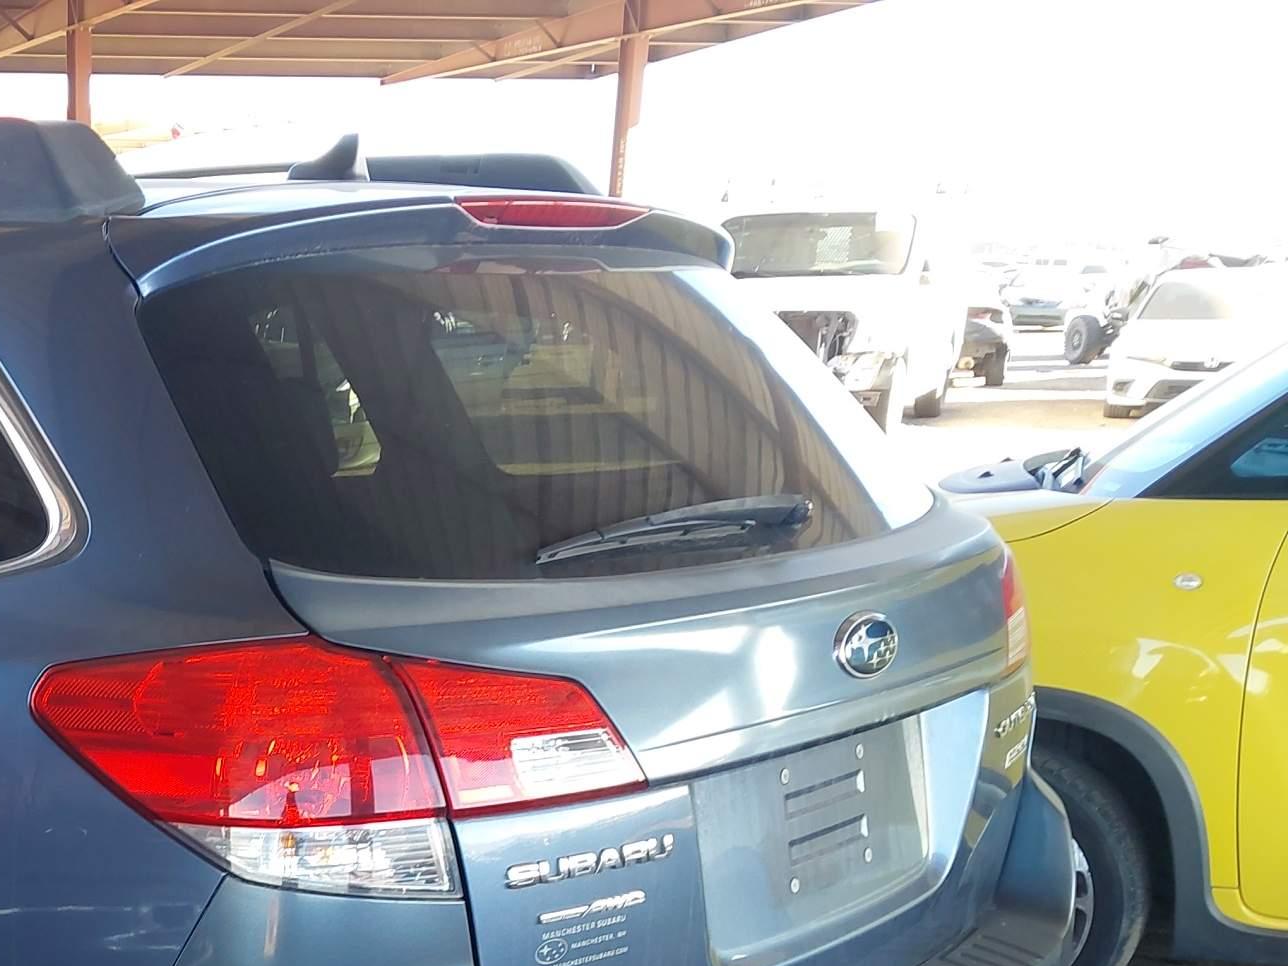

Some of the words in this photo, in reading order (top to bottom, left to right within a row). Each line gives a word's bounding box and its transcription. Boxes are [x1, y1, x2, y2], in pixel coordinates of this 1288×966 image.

[505, 834, 674, 889] SUBARU
[541, 921, 595, 940] MANCHESTER
[596, 914, 627, 929] SUBARU
